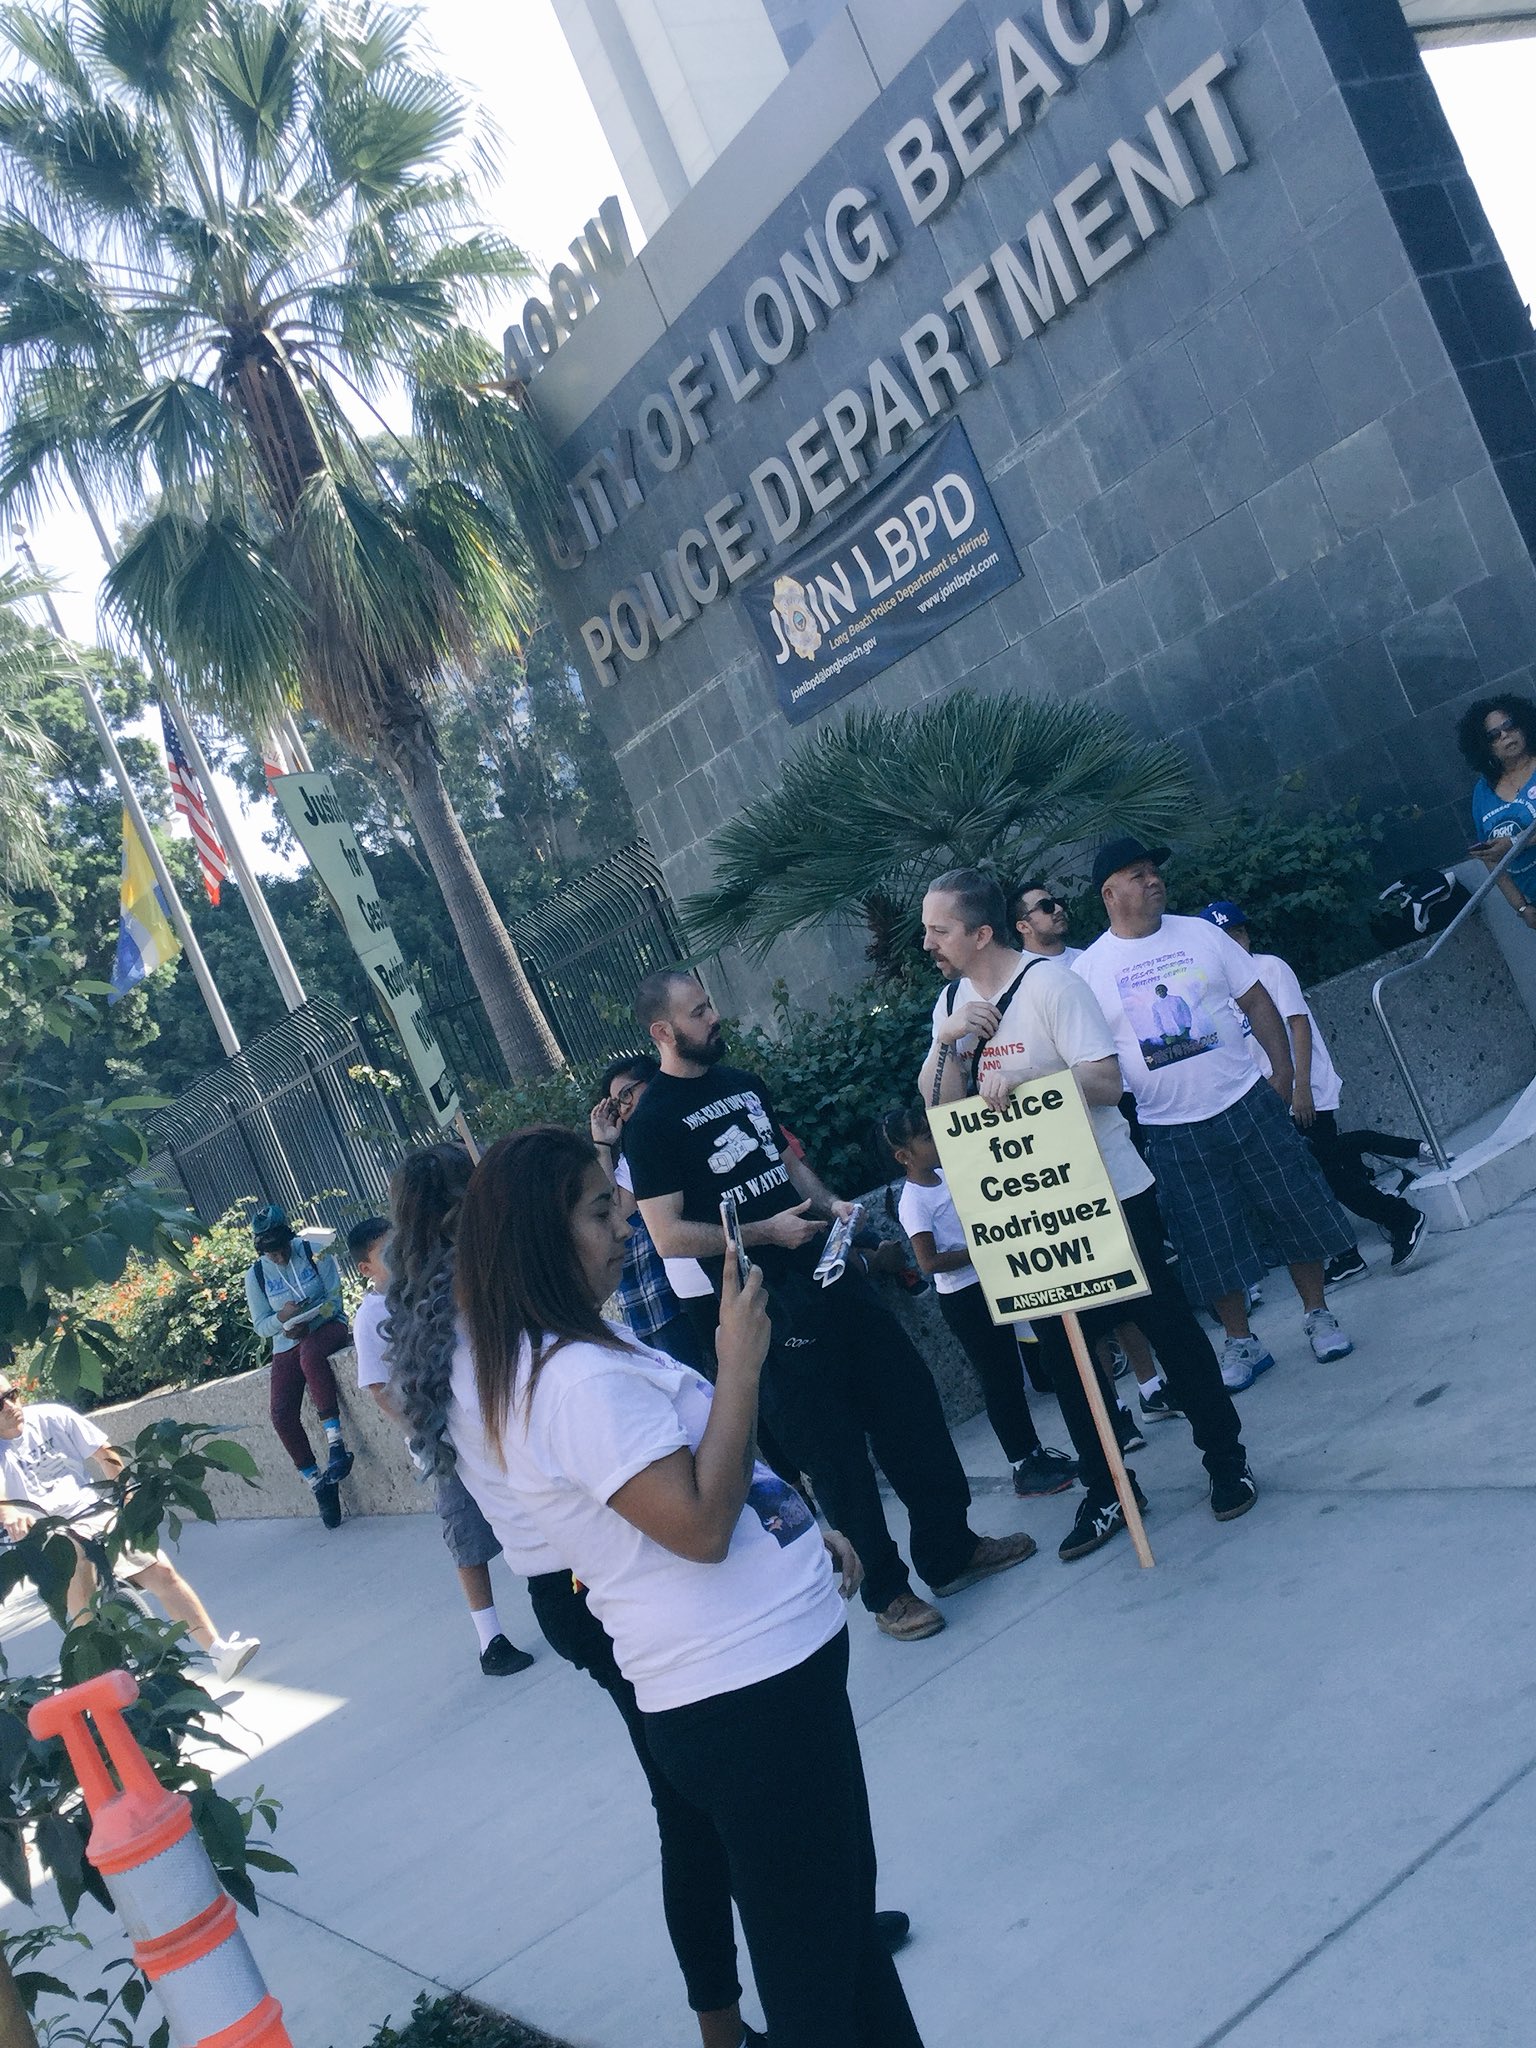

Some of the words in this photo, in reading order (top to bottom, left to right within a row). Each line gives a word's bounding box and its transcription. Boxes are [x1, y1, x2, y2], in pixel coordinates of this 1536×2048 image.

[639, 355, 712, 473] OF
[709, 186, 893, 404] LONG
[884, 0, 1144, 228] BEAC
[580, 494, 762, 688] POLICE
[749, 51, 1244, 545] DEPARTMENT
[851, 473, 975, 599] LBPD
[829, 631, 850, 651] Long
[848, 616, 872, 637] Beach
[870, 597, 897, 624] Police
[895, 558, 950, 602] Department
[947, 553, 959, 566] is
[956, 528, 991, 559] Hiring!
[917, 552, 1000, 613] www.joinlbpd.com
[790, 636, 878, 703] joinlbpd@longbeach.gov
[1211, 910, 1230, 926] LA
[682, 1111, 709, 1131] LONG
[700, 1099, 731, 1121] BEACH
[946, 1089, 1064, 1138] Justice
[989, 1134, 1034, 1163] for
[980, 1162, 1072, 1202] Cesar
[971, 1197, 1112, 1247] Rodriguez
[1006, 1236, 1096, 1278] NOW!
[1012, 1279, 1117, 1310] ANSWER-LA.org
